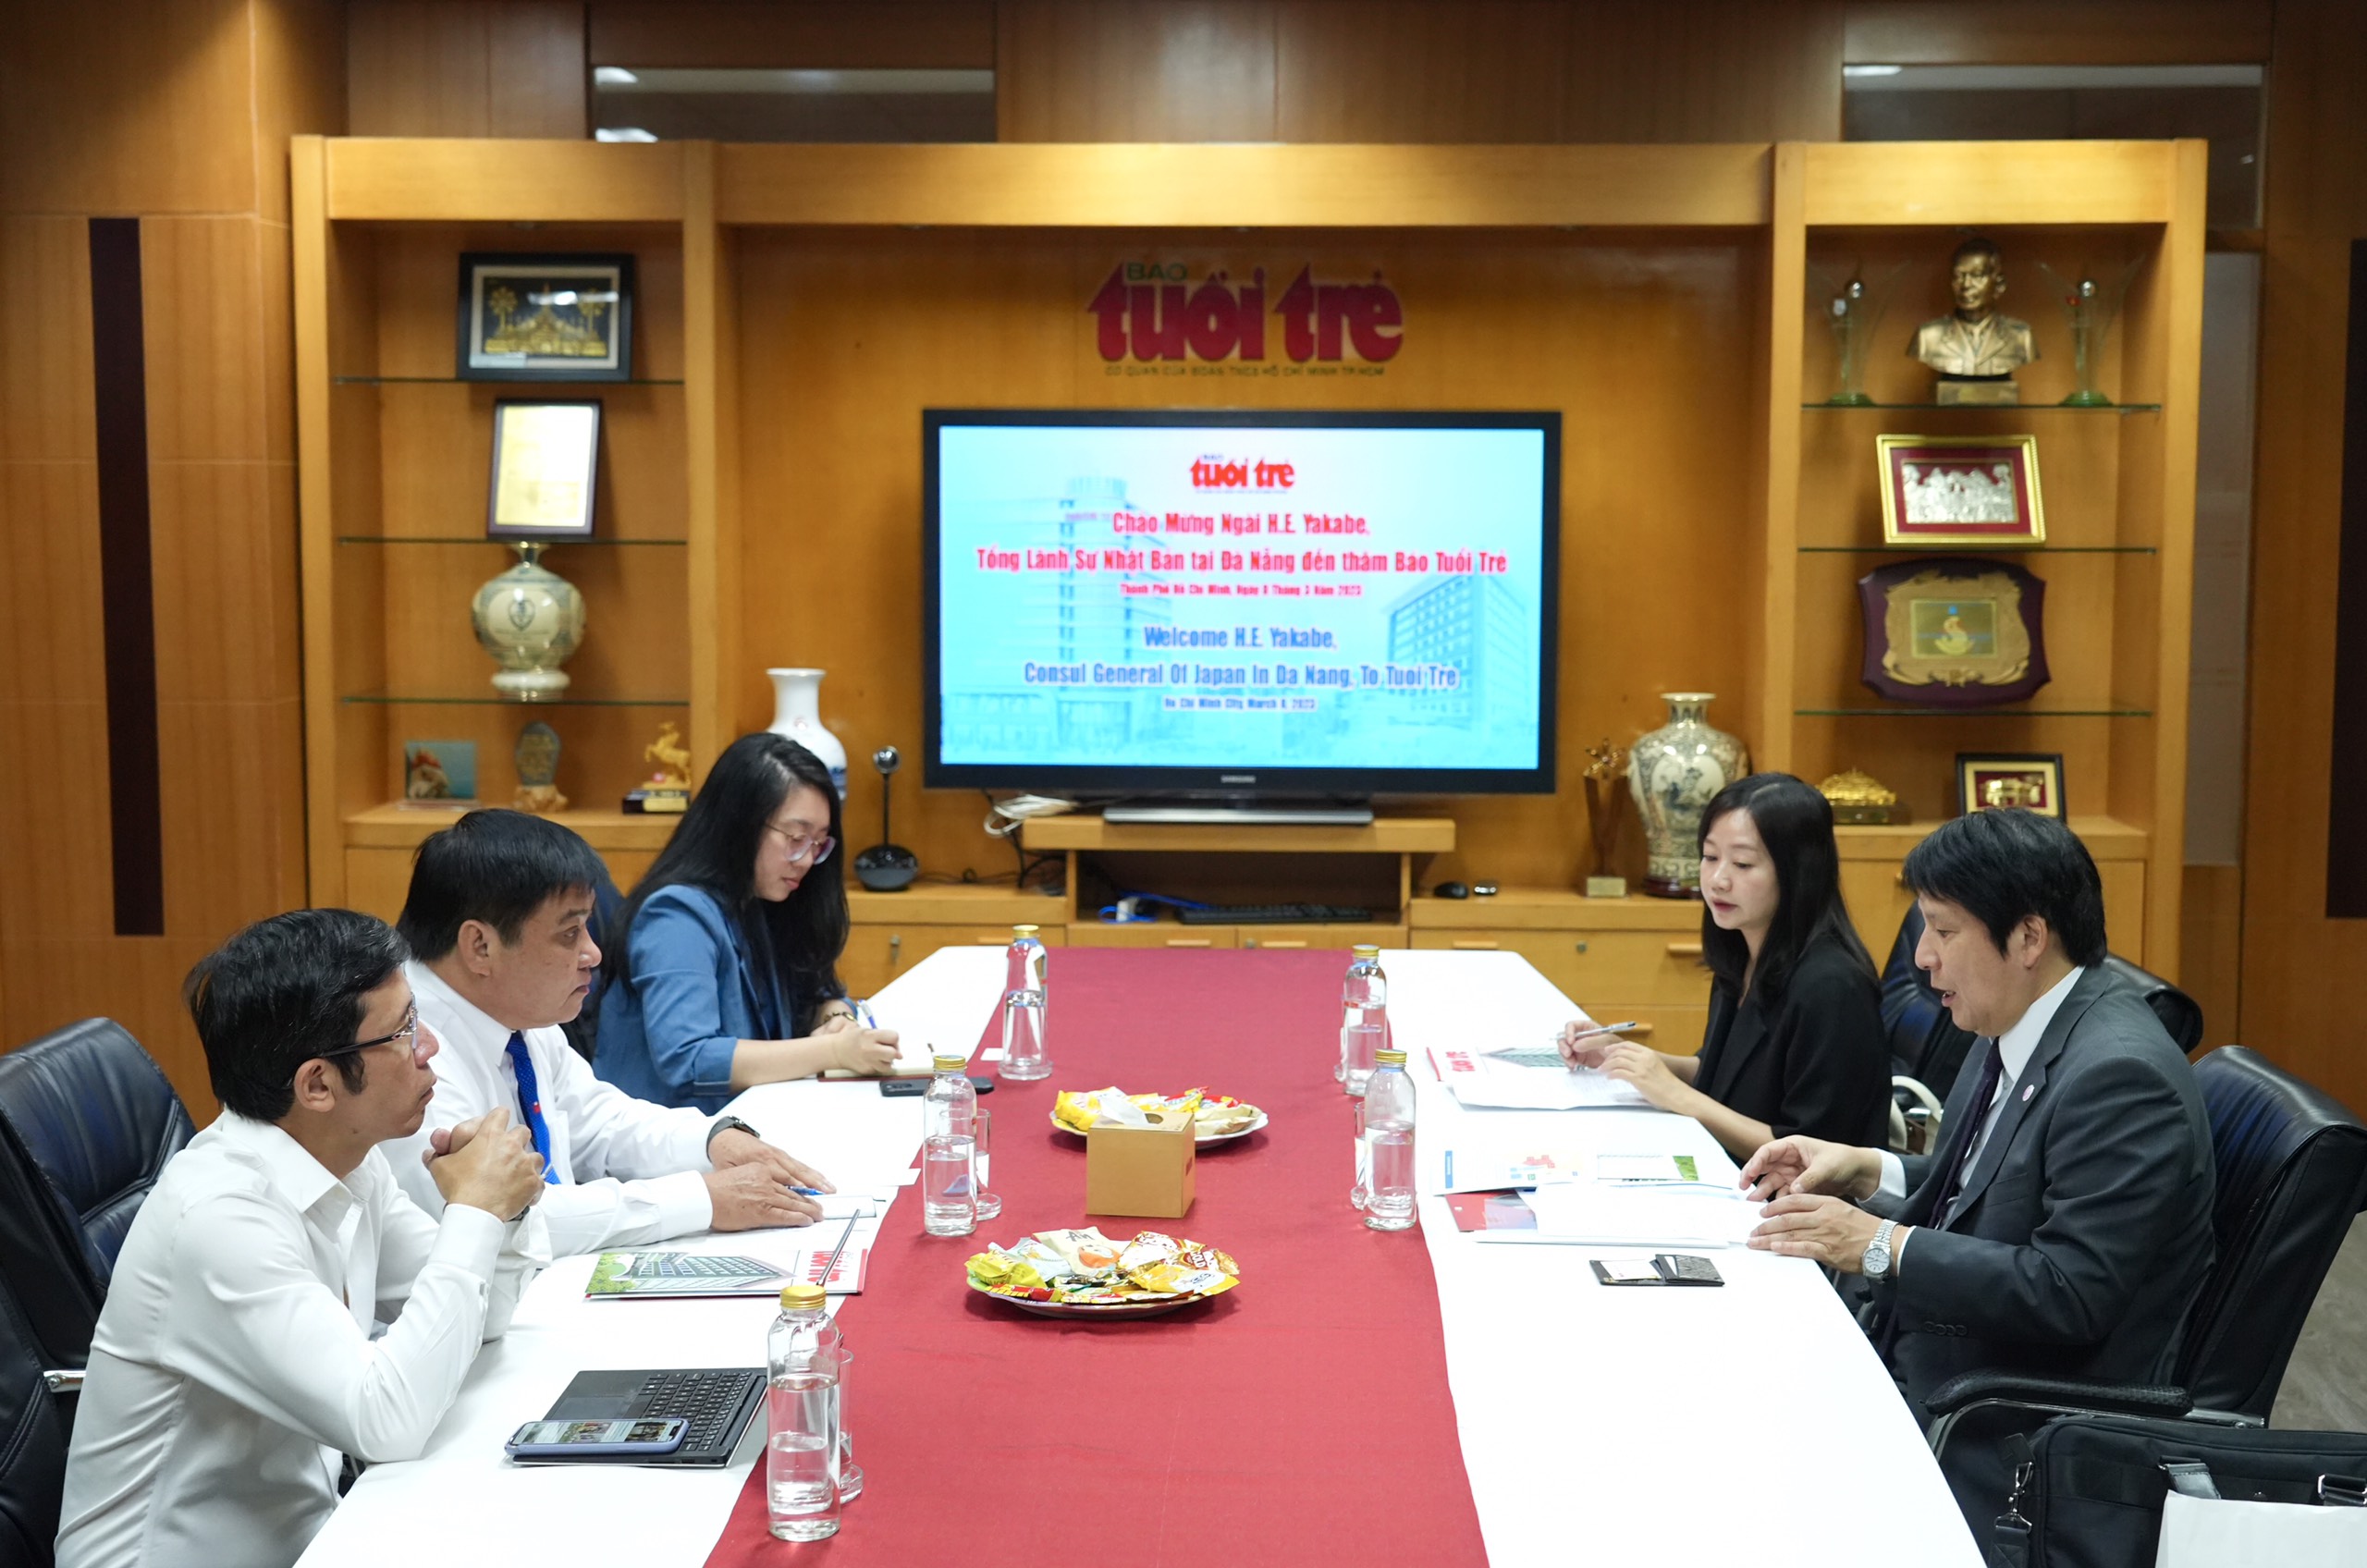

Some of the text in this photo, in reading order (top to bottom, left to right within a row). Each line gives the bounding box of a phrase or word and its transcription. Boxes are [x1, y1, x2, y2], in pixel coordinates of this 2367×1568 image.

[1144, 626, 1228, 647] Welcome
[1269, 628, 1336, 649] Yakabe,
[1024, 662, 1456, 687] Consul General Of Japan In Da Nang, To Tuoi Tre
